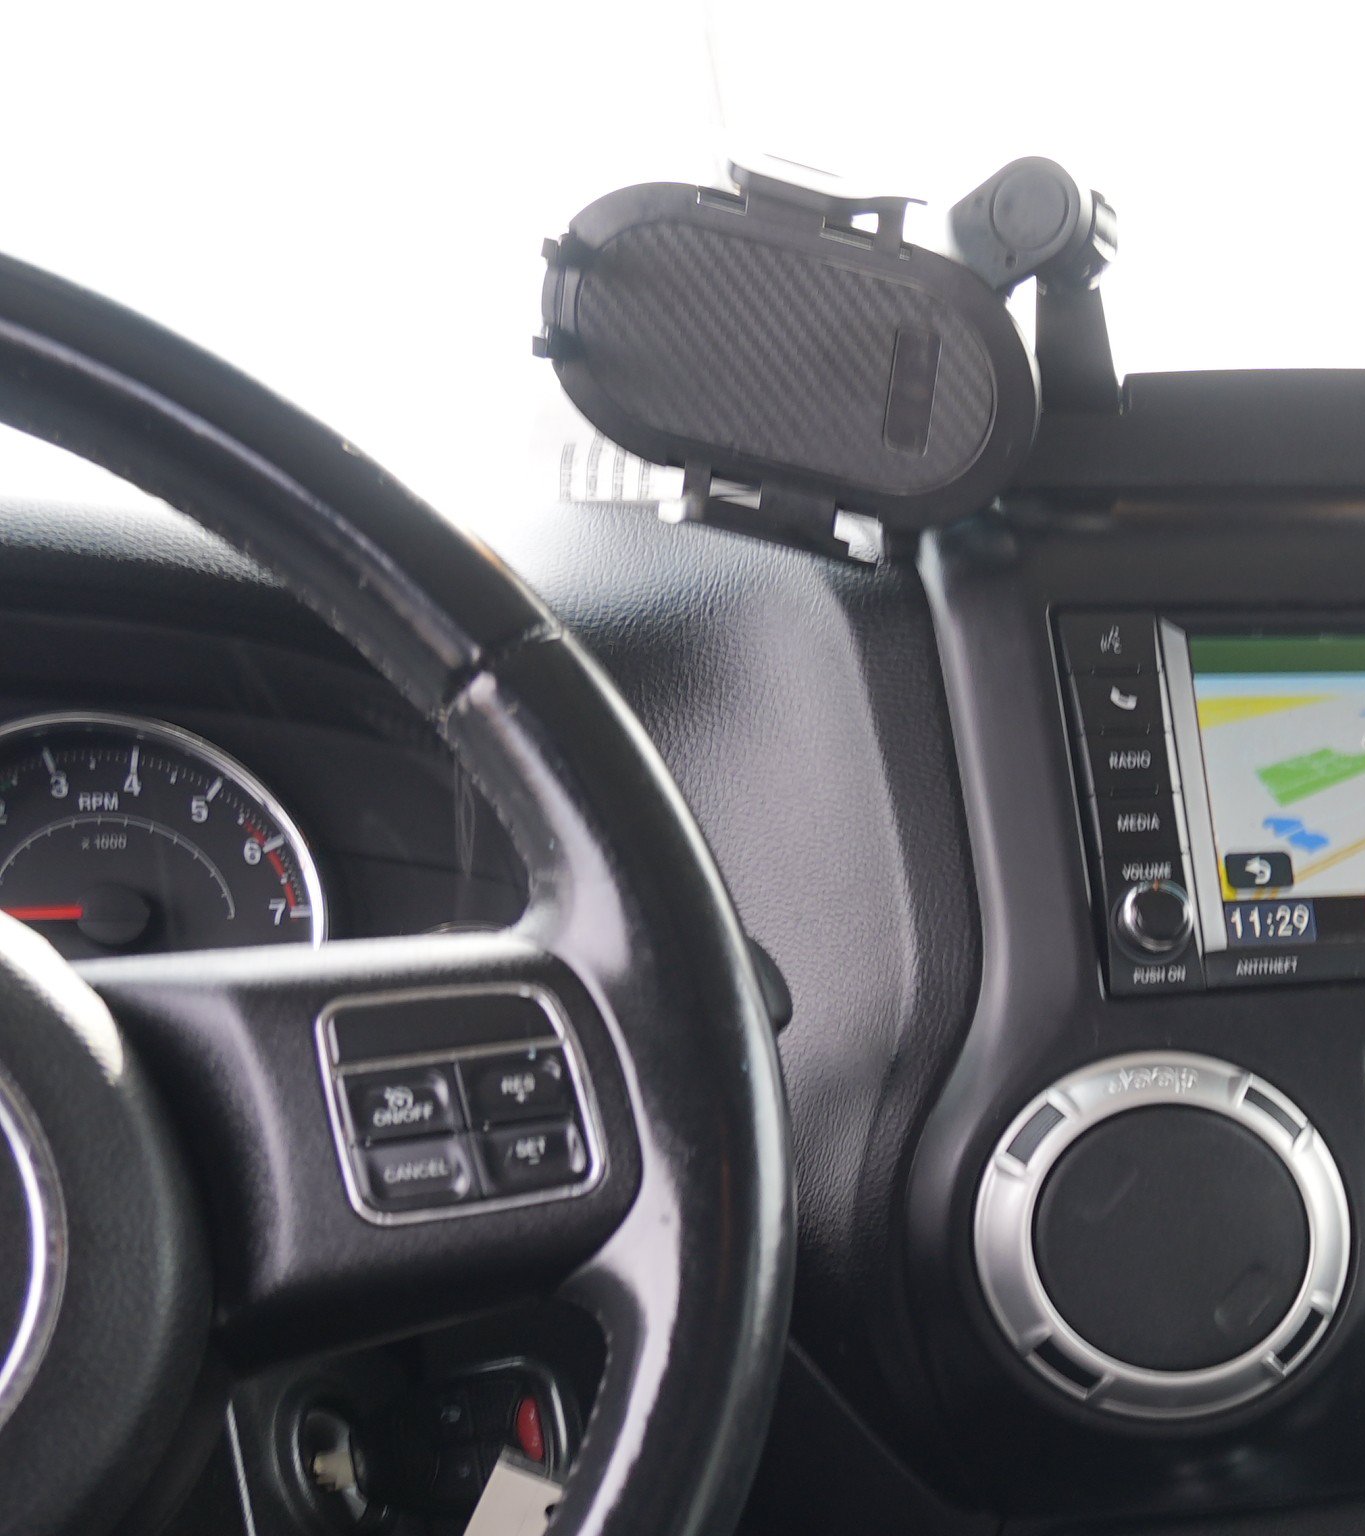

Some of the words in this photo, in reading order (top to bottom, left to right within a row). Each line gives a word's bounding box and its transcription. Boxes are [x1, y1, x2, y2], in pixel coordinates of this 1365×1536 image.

[1109, 750, 1151, 770] RADIO
[50, 770, 69, 799] 3
[123, 770, 142, 797] 4
[78, 792, 119, 812] RPM
[190, 794, 209, 823] 5
[1117, 813, 1160, 833] MEDIA
[243, 836, 262, 865] 6
[1122, 861, 1173, 881] VOLUME
[268, 898, 287, 926] 7
[1231, 904, 1310, 939] 11:29
[1134, 965, 1166, 986] PUSH
[1168, 964, 1186, 983] ON
[1236, 955, 1299, 977] ANTITHEFT
[384, 1157, 449, 1184] CANCEL
